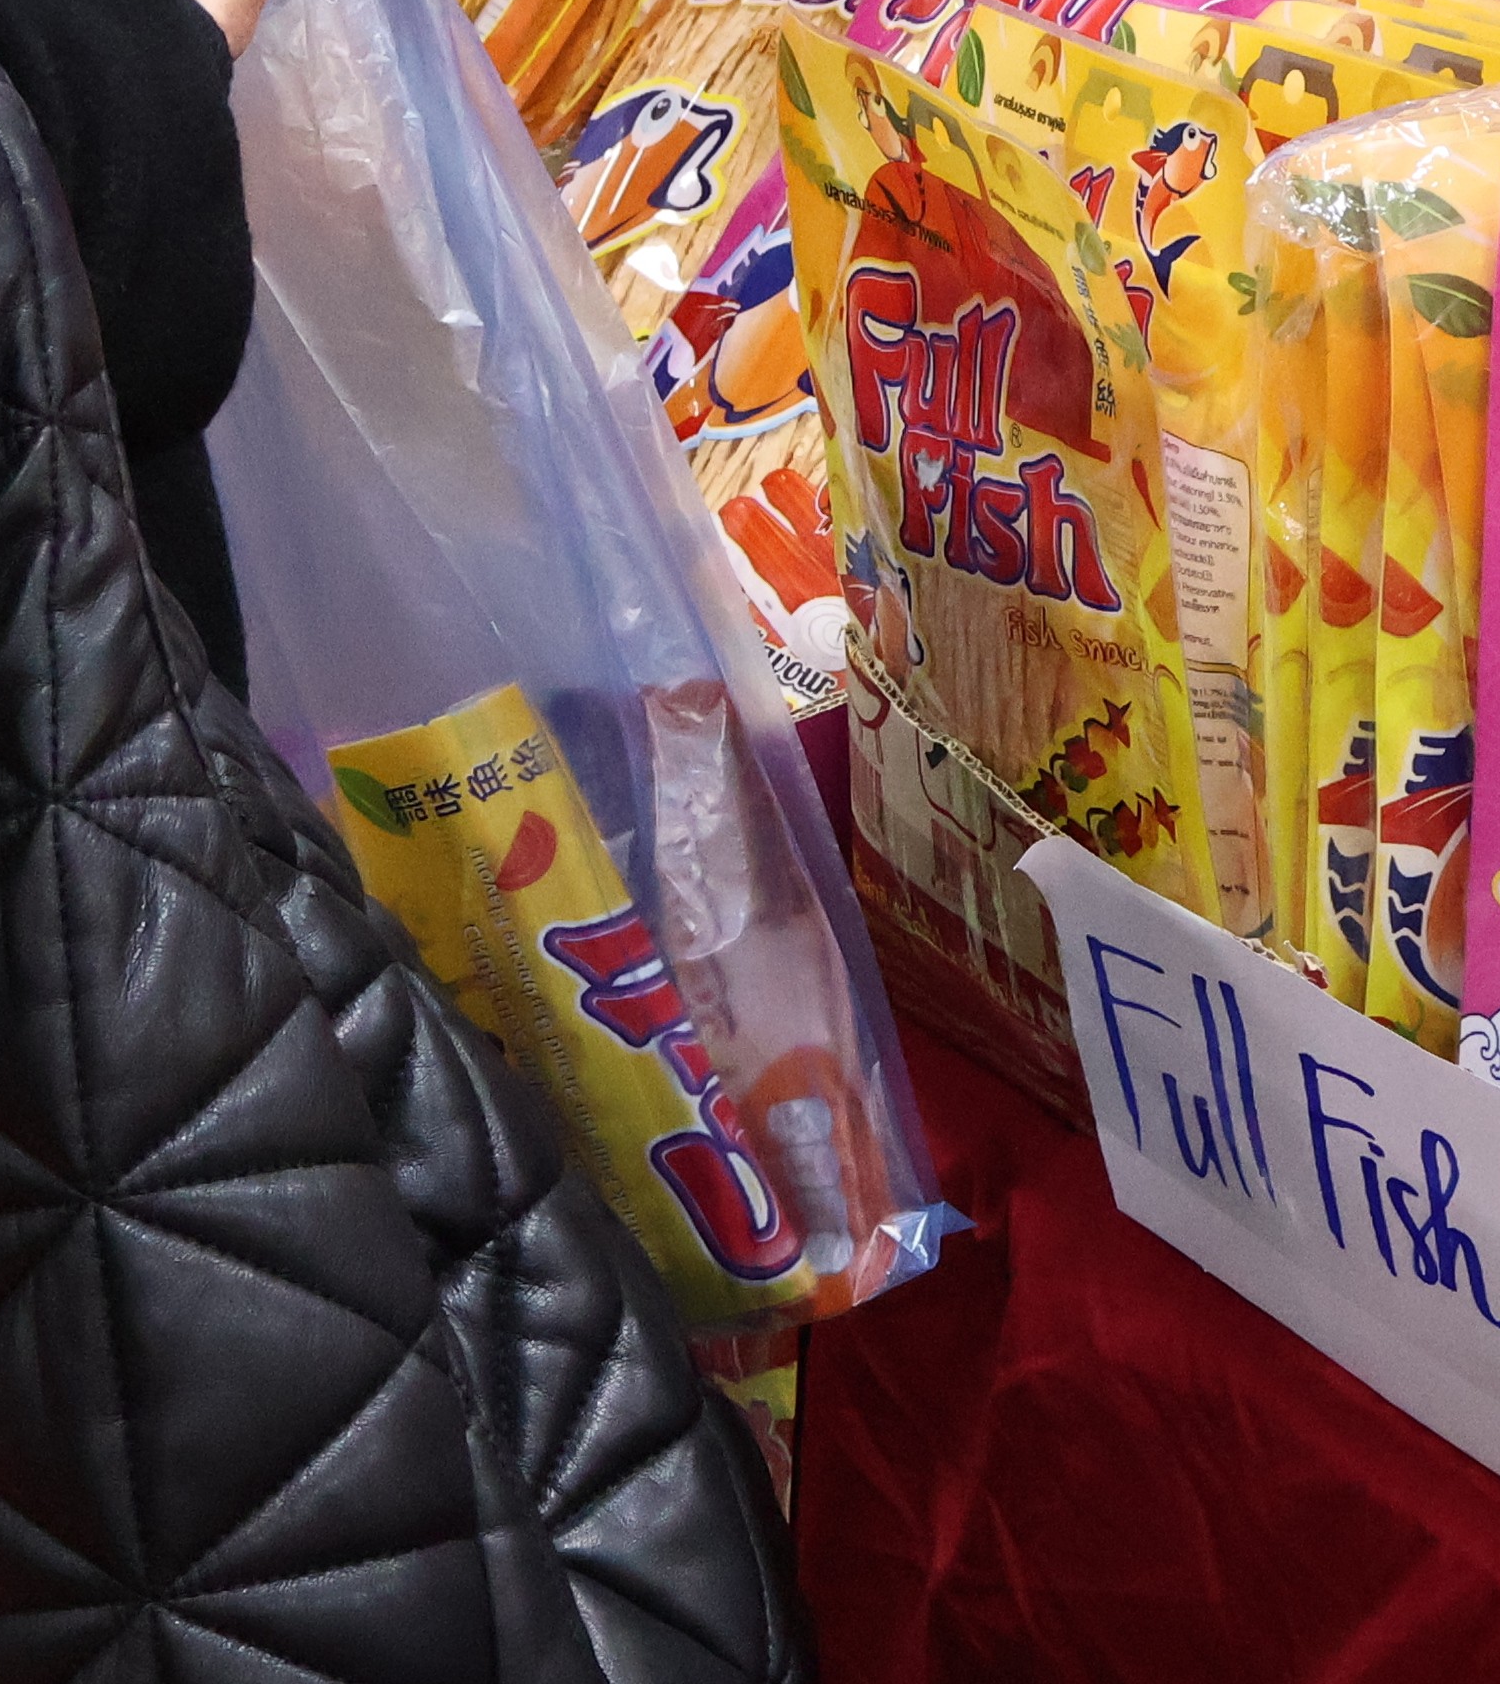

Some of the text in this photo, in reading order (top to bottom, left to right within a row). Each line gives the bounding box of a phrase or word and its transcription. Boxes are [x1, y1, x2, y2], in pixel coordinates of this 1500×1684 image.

[846, 267, 1015, 453] Full
[898, 424, 1121, 615] Fish
[1002, 605, 1061, 650] Fish
[1087, 935, 1277, 1207] Full
